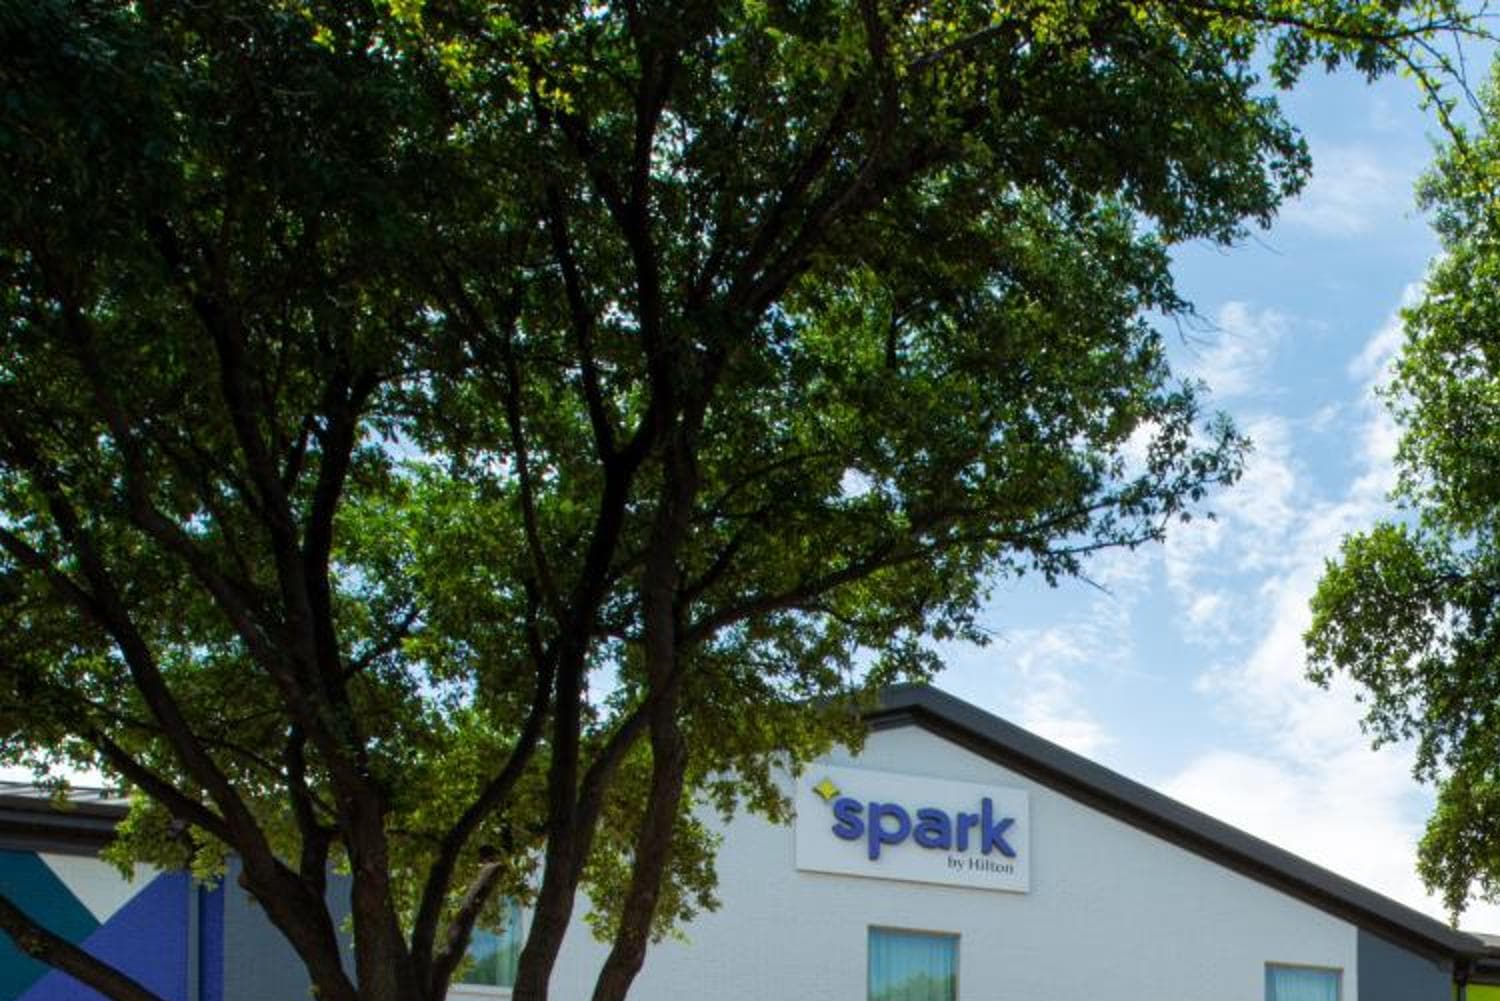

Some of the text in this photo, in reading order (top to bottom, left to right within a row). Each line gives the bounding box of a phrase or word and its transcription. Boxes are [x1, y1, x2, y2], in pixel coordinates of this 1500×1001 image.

[832, 797, 1016, 861] spark
[947, 856, 1014, 875] by Hilton
